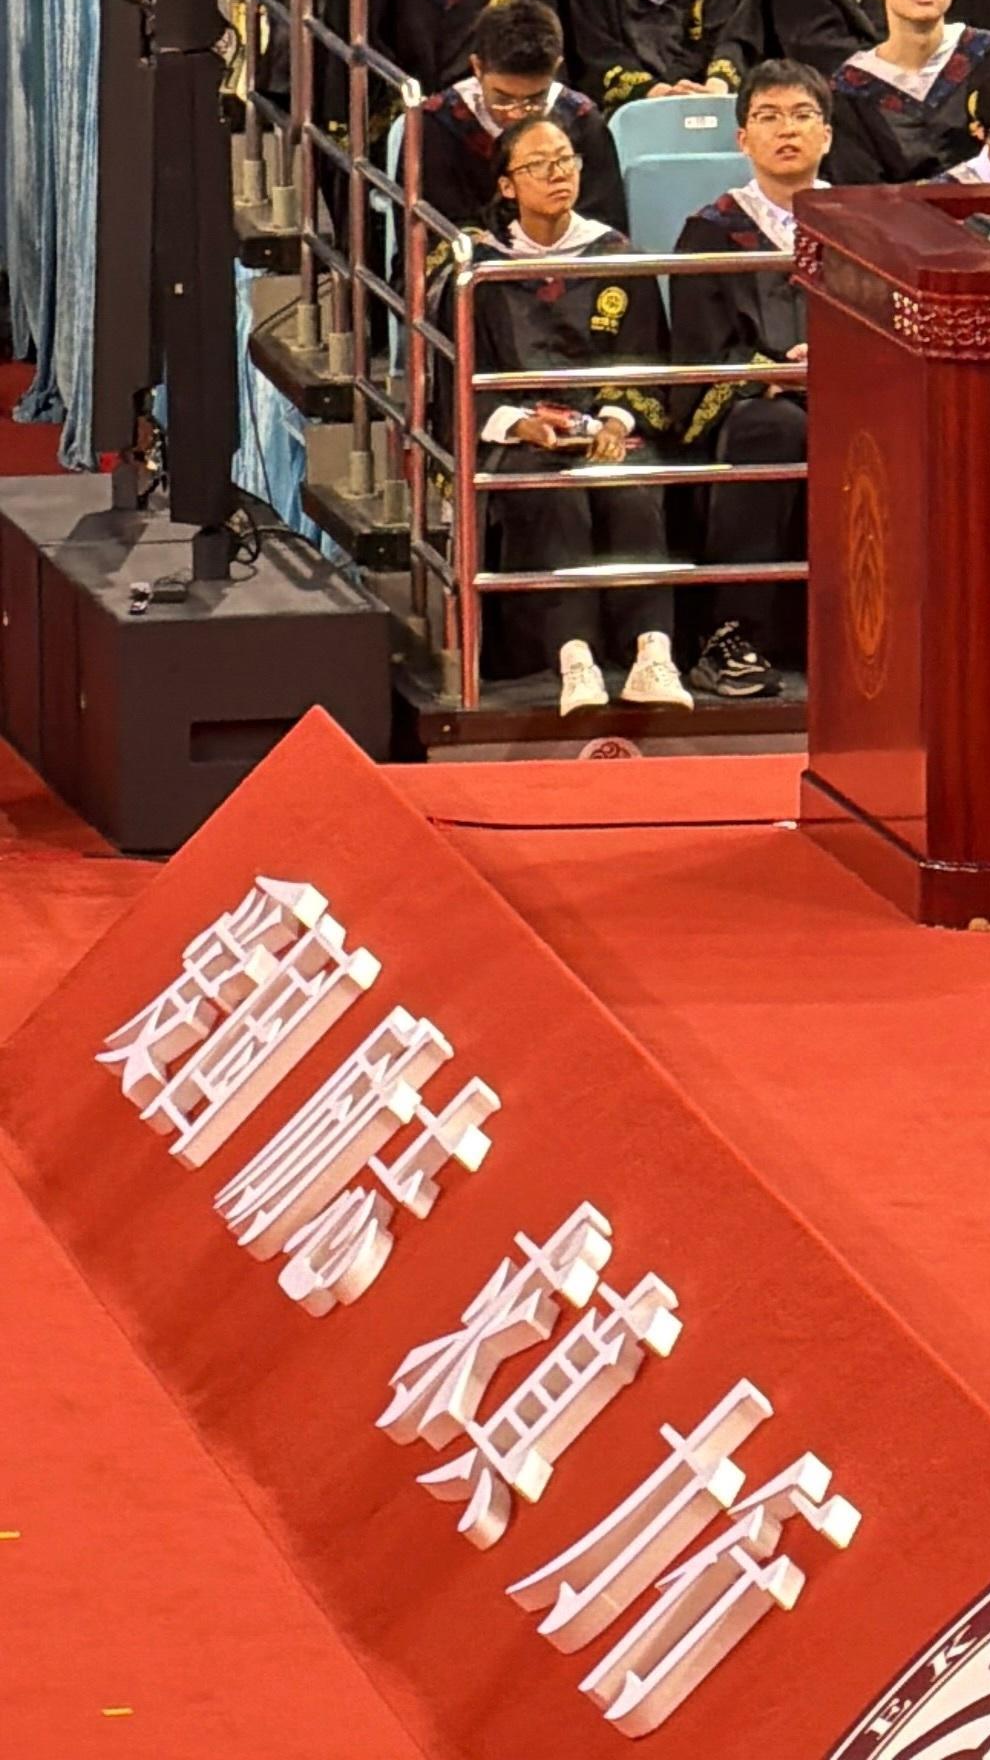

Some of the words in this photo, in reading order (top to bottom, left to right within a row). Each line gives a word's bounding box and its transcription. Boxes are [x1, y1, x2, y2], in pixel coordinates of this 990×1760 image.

[95, 875, 381, 1168] 爱国
[213, 1006, 501, 1317] 励志
[374, 1200, 683, 1551] 求真
[505, 1377, 862, 1738] 力行
